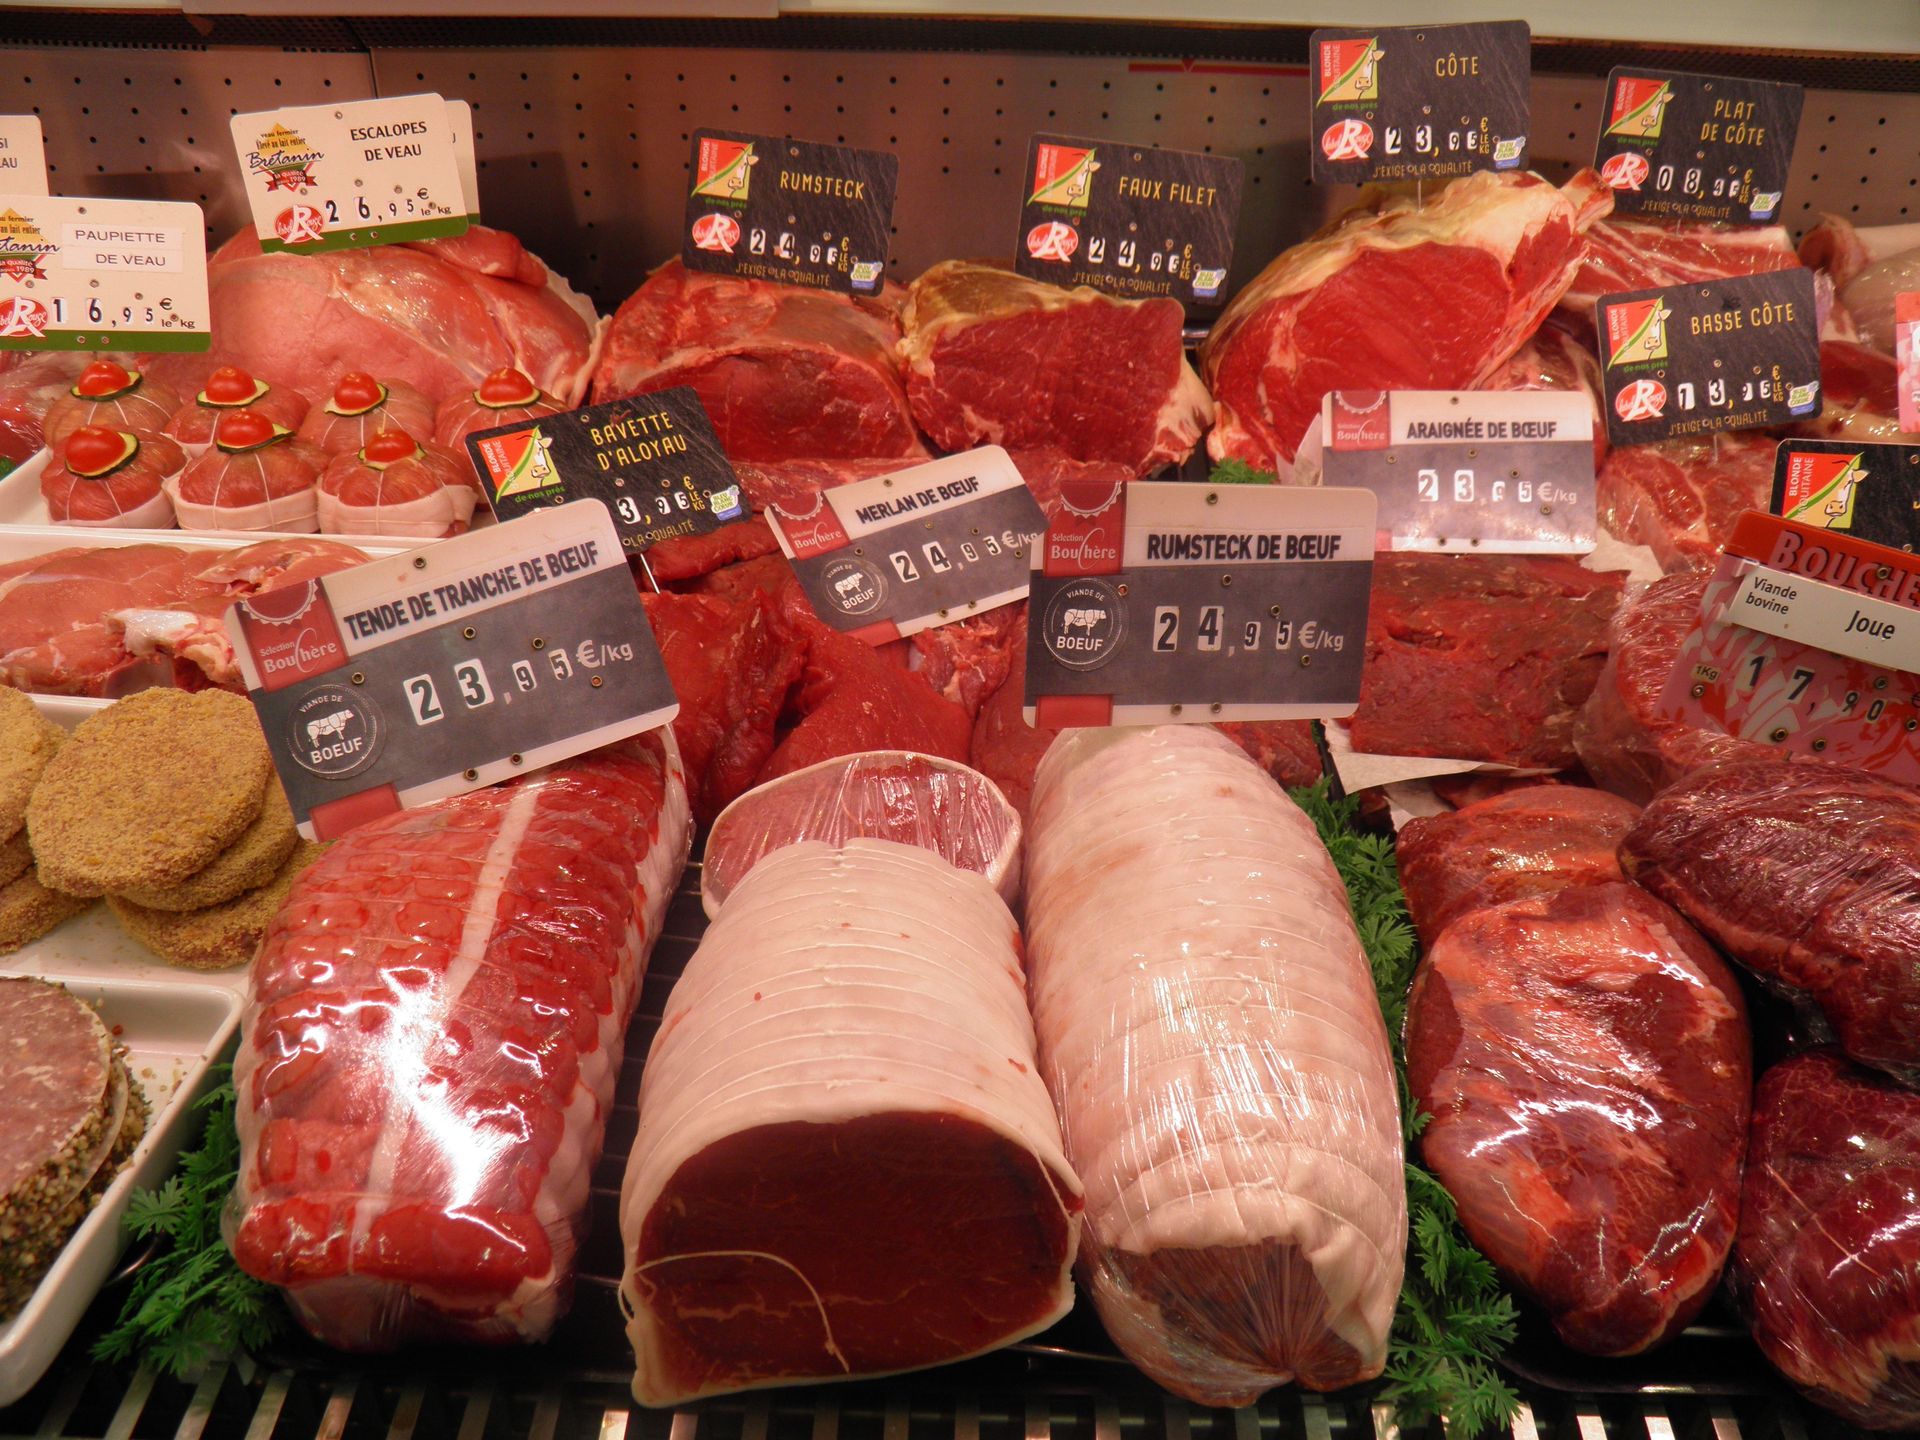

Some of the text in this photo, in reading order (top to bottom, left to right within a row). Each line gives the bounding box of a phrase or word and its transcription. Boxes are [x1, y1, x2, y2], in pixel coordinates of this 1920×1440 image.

[1436, 52, 1479, 77] CÔTE
[1714, 99, 1755, 120] PLAT
[350, 121, 427, 141] ESCALOPES
[1480, 117, 1489, 131] €
[1480, 134, 1489, 143] LE
[1701, 122, 1765, 146] DE CÔTE
[365, 144, 422, 162] DE VEAU
[1479, 144, 1490, 154] KG
[246, 148, 325, 169] Bretanin
[1373, 165, 1405, 179] J'EXIGE
[1414, 163, 1426, 175] LA
[780, 171, 865, 199] RUMSTECK
[1119, 176, 1216, 207] FAUX FILET
[417, 188, 429, 200] €
[421, 206, 451, 216] le kg
[75, 230, 166, 243] PAUPIETTE
[841, 237, 850, 251] €
[839, 253, 848, 262] LE
[1184, 244, 1193, 259] €
[95, 254, 166, 266] DE VEAU
[838, 262, 848, 273] KG
[1181, 260, 1190, 270] LE
[16, 266, 35, 274] 1989
[775, 268, 786, 280] LA
[1072, 272, 1105, 286] J'EXIGE
[1113, 276, 1126, 288] LA
[160, 298, 172, 310] €
[161, 318, 196, 329] le kg
[1691, 302, 1795, 335] BASSE CÔTE
[1772, 365, 1781, 380] €
[1773, 382, 1782, 392] LE
[1773, 392, 1784, 402] KG
[591, 411, 674, 446] BAVETTE
[1407, 417, 1557, 439] ARAIGNÉE DE BŒUF
[1669, 420, 1701, 436] J'EXIGE
[1711, 417, 1722, 429] LA
[482, 443, 501, 473] BLONDE
[597, 434, 688, 471] D'ALOYAU
[683, 476, 694, 491] €
[1789, 457, 1801, 497] BLONDE
[515, 485, 565, 503] de nos prés
[689, 491, 700, 502] LE
[856, 477, 980, 524] MERLAN DE BŒUF
[693, 500, 705, 511] KG
[630, 534, 646, 547] LA
[1147, 533, 1342, 560] RUMSTECK DE BŒUF
[344, 540, 598, 640] TENDE DE TRANCHE DE BŒUF
[1066, 588, 1104, 602] VIANDE DE
[1754, 576, 1797, 600] Viande
[842, 588, 875, 609] BOEUF
[1745, 591, 1789, 615] bovine
[1845, 610, 1896, 640] Joue
[1056, 635, 1104, 652] BOEUF
[300, 694, 343, 713] VIANDE DE
[310, 737, 363, 764] BOEUF
